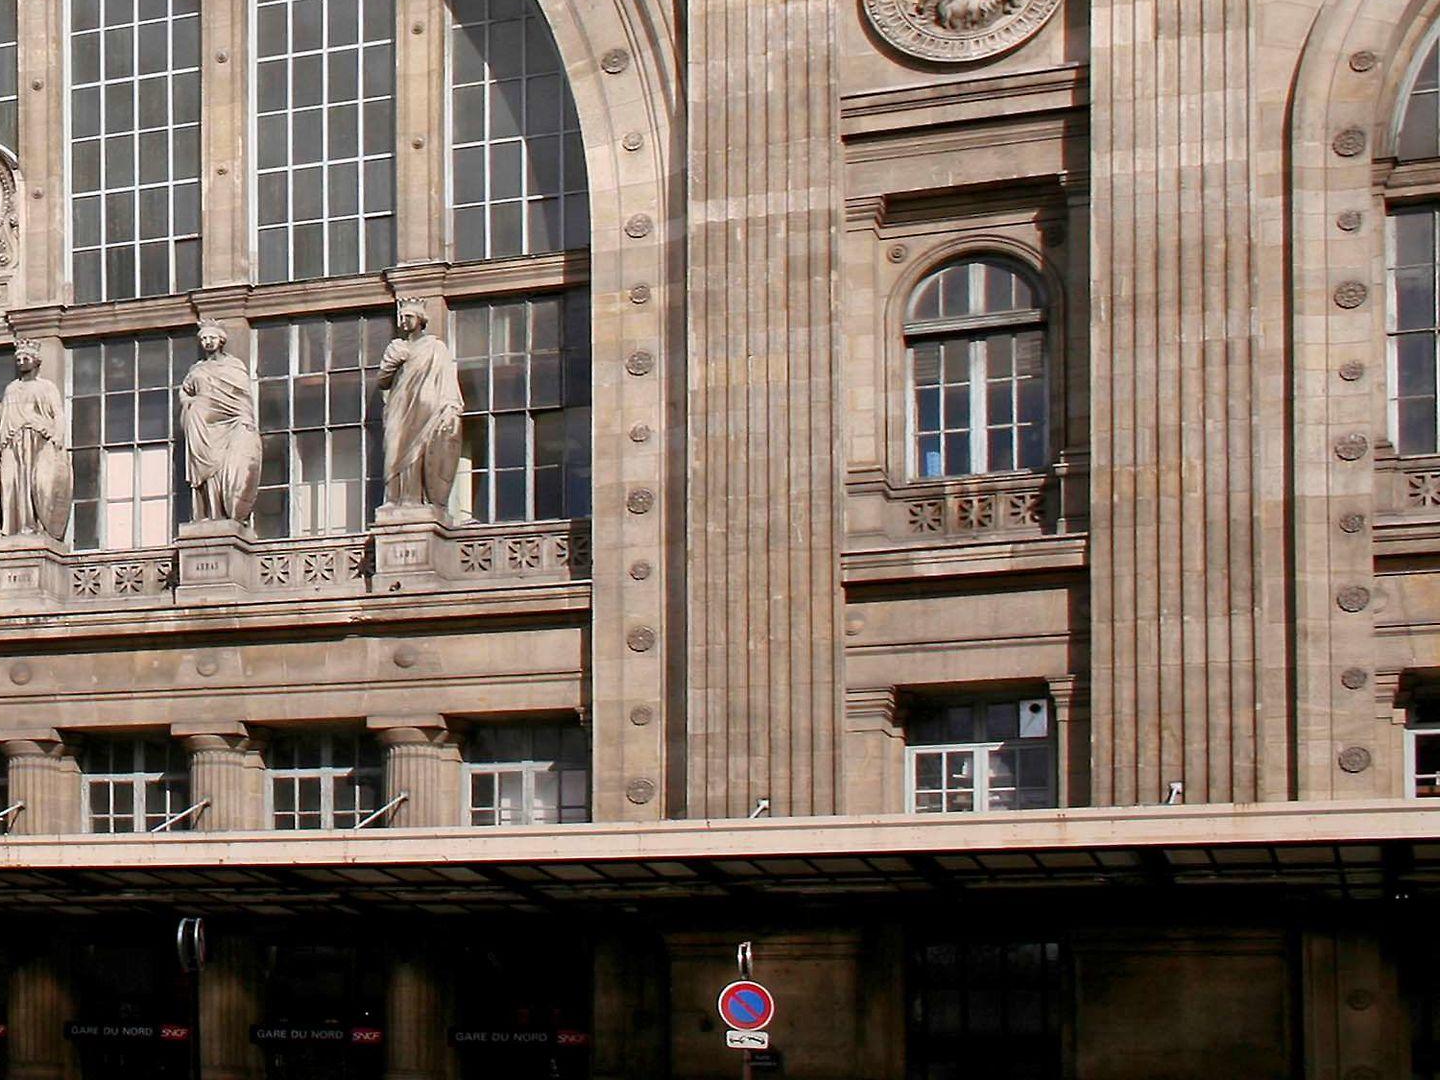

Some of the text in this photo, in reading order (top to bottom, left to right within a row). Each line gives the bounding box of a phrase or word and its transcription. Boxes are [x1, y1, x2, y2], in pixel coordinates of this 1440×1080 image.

[257, 1029, 344, 1040] GARE DU NORD
[352, 1031, 382, 1041] SNCF
